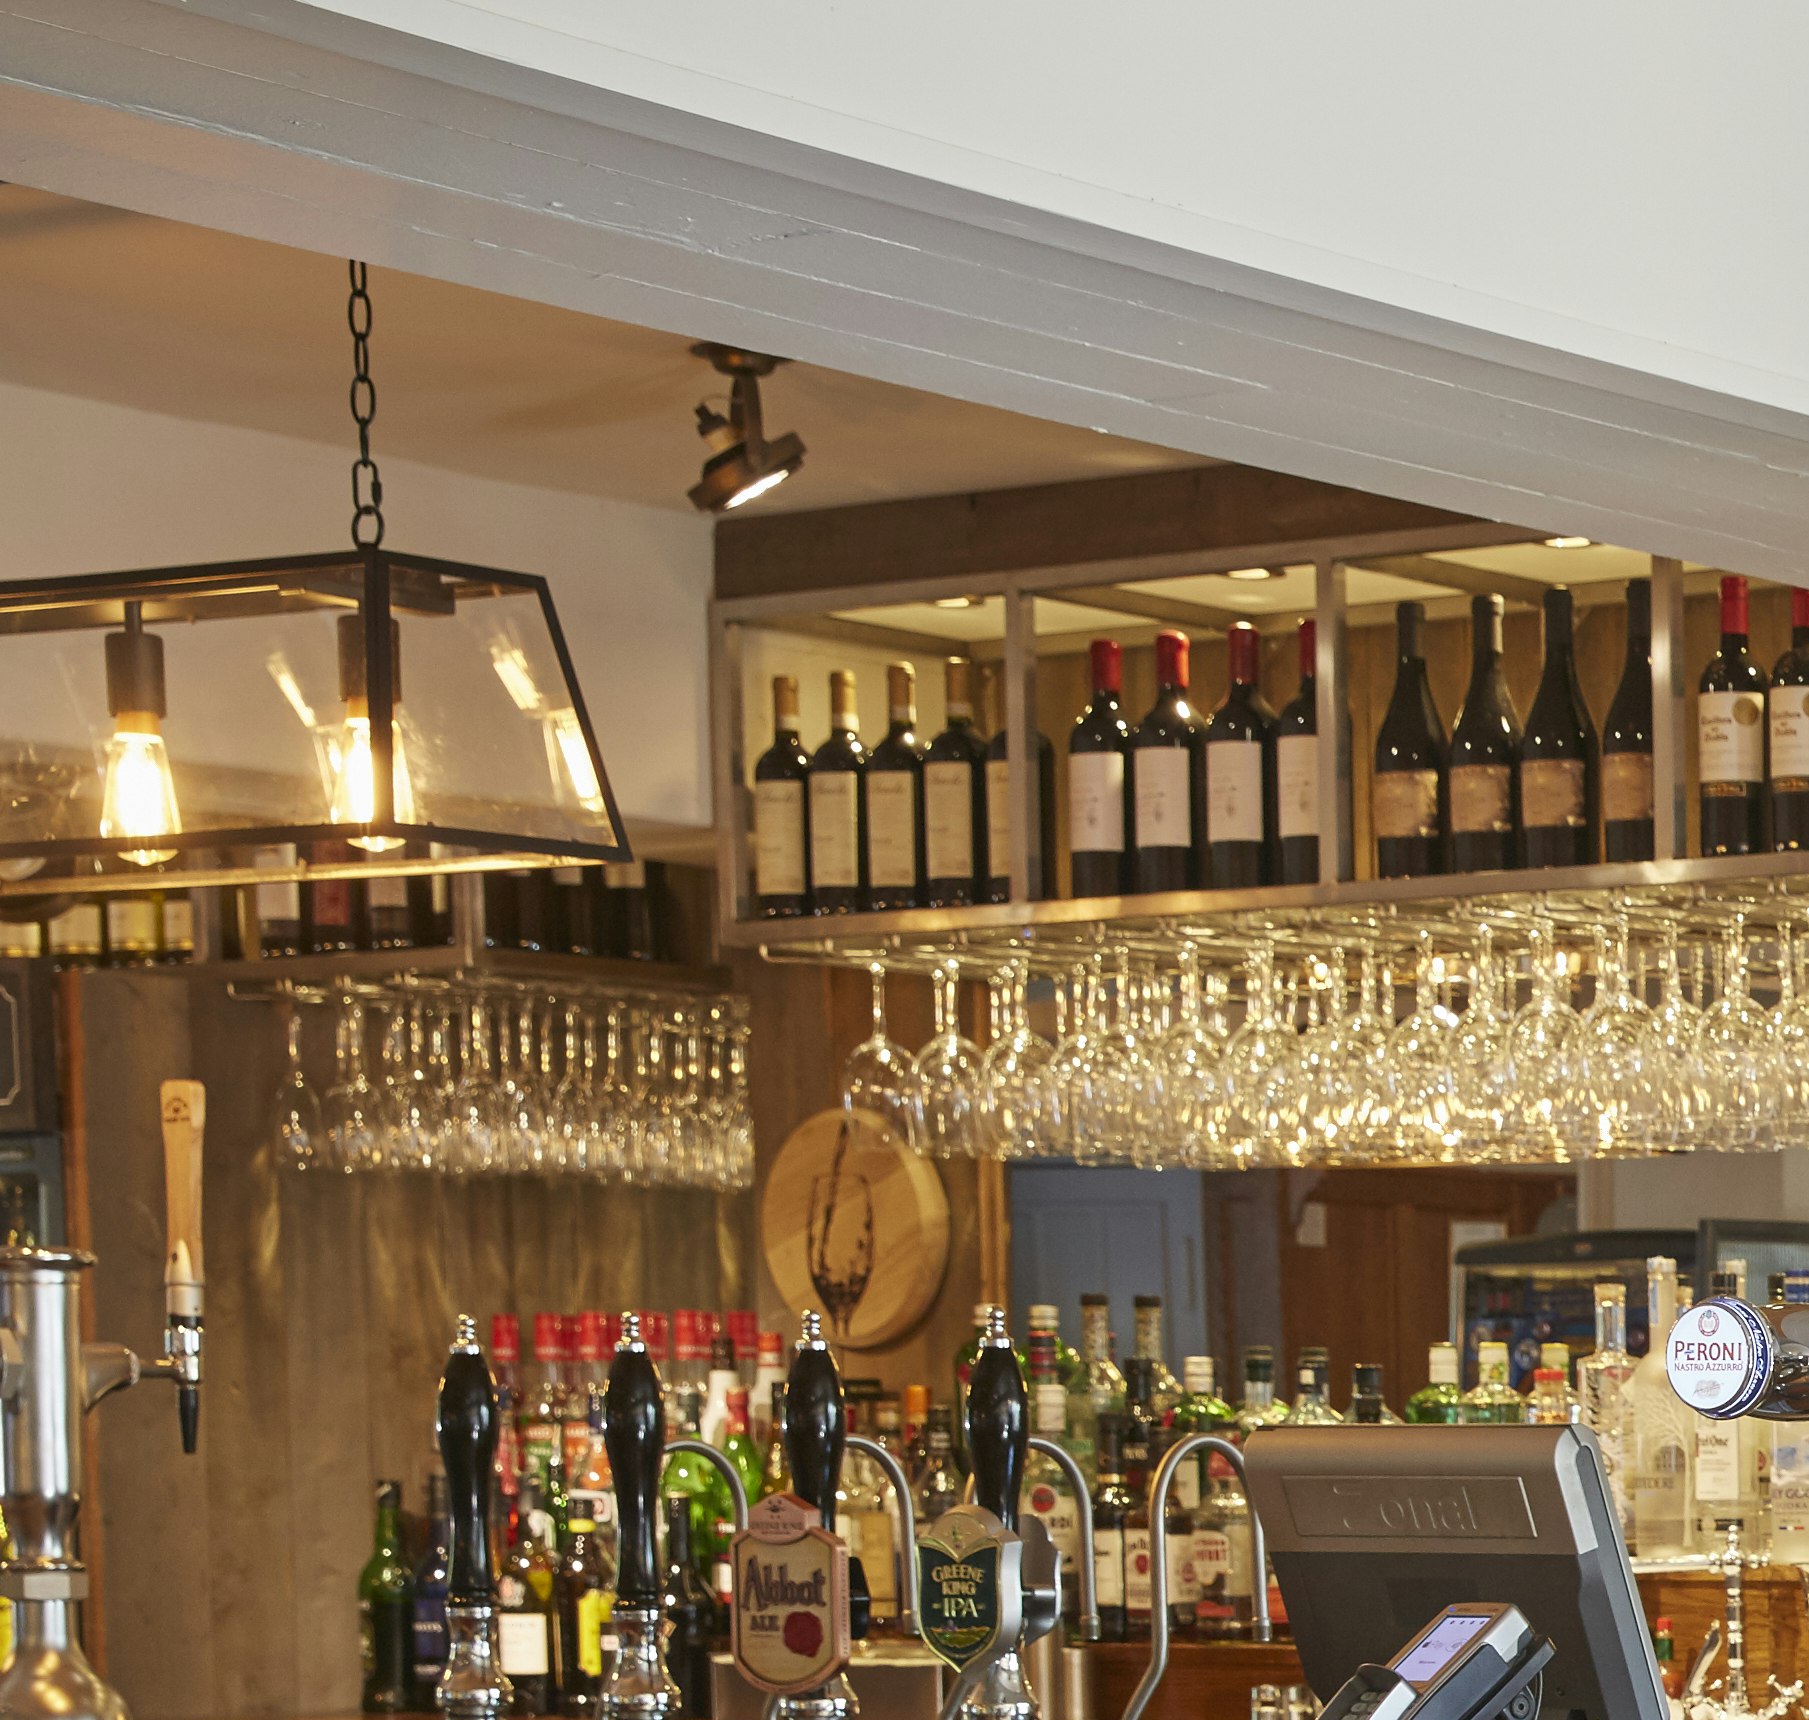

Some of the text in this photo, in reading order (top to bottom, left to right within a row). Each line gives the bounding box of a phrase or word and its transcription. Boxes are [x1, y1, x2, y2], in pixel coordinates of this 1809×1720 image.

[1674, 1340, 1743, 1361] PERONI
[1674, 1362, 1744, 1372] NASTRO AZZURRO
[1331, 1483, 1479, 1531] Zonal
[741, 1555, 827, 1612] Abbot
[931, 1563, 986, 1584] GREENE
[942, 1580, 977, 1596] KING
[942, 1597, 979, 1618] IPA
[751, 1615, 780, 1632] ALE
